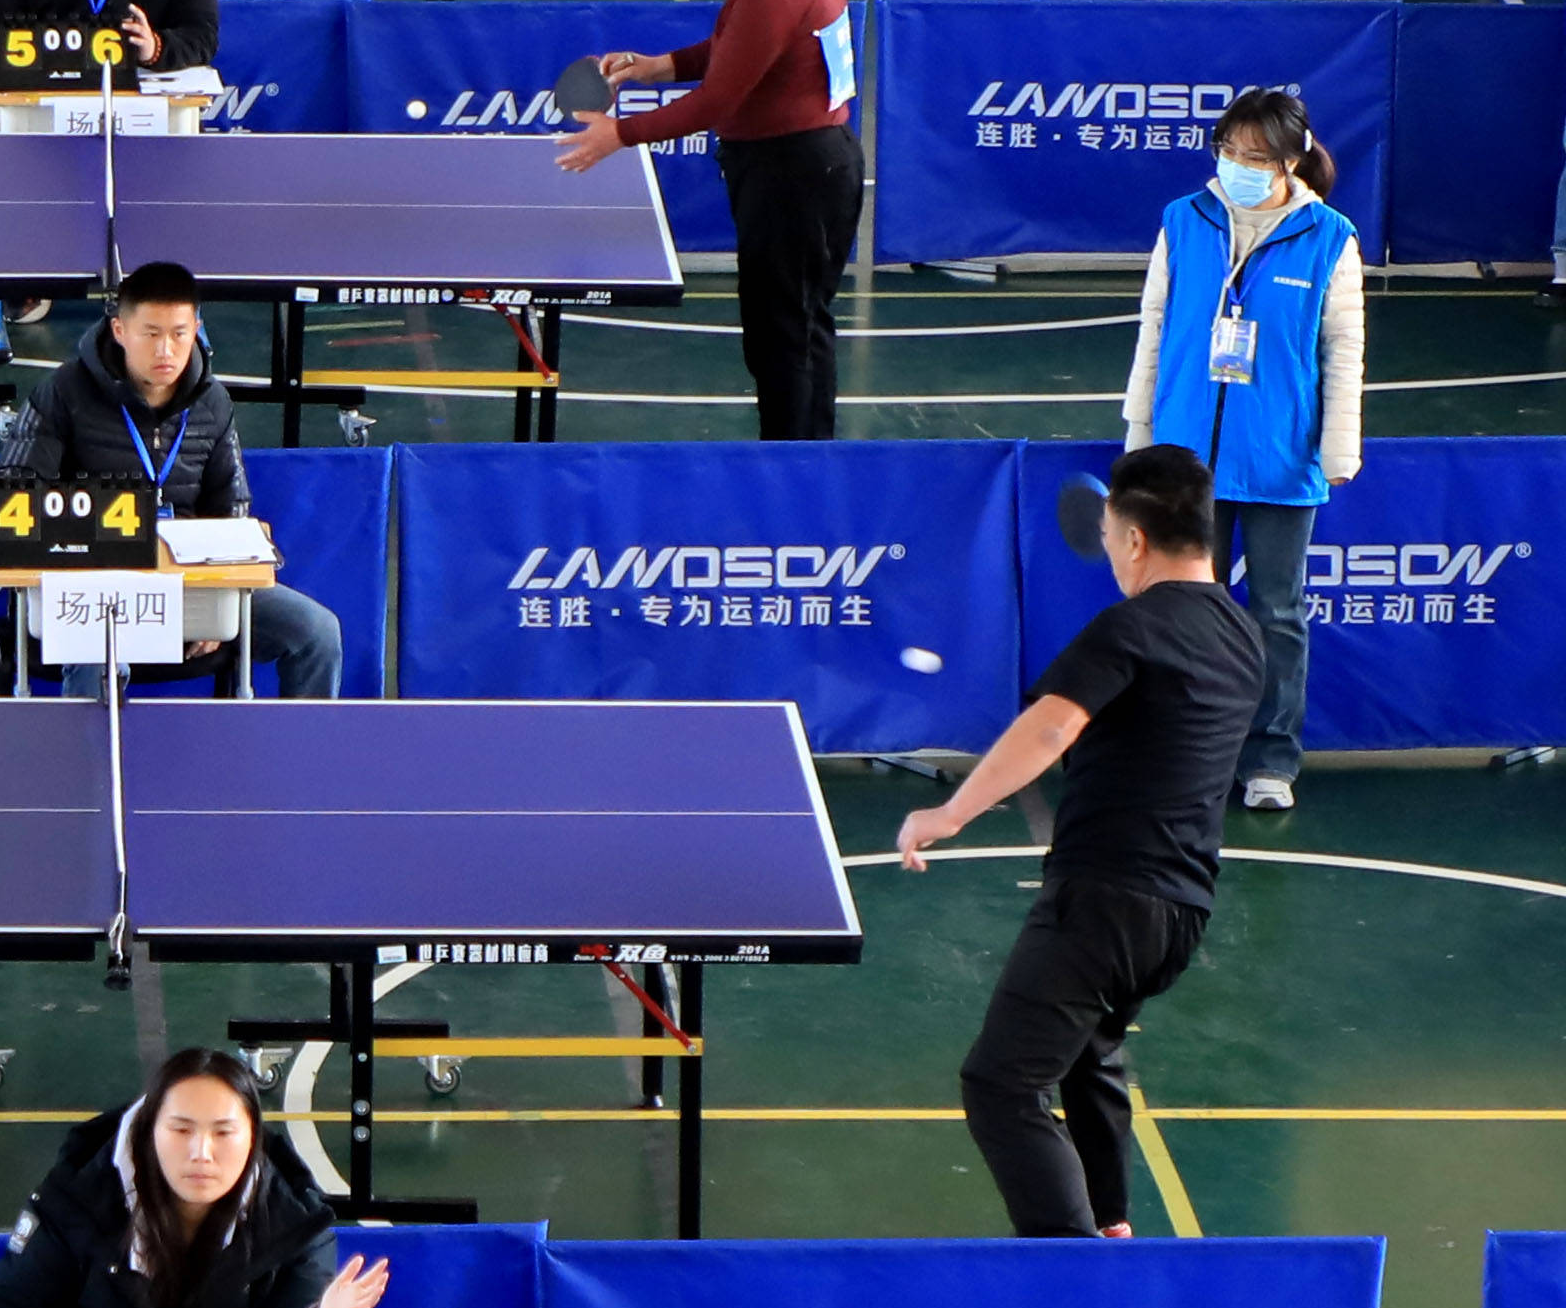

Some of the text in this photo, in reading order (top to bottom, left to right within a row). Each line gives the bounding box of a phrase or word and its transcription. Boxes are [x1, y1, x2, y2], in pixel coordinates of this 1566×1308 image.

[5, 29, 37, 68] 5
[91, 29, 123, 66] 6
[967, 81, 1265, 119] LANDSO
[975, 121, 1205, 151] 连胜·专为运动
[102, 492, 141, 537] 4
[1304, 541, 1513, 587] DSON
[56, 590, 167, 626] 场地四
[1304, 593, 1497, 625] 为运动而生
[613, 943, 668, 963] 双鱼
